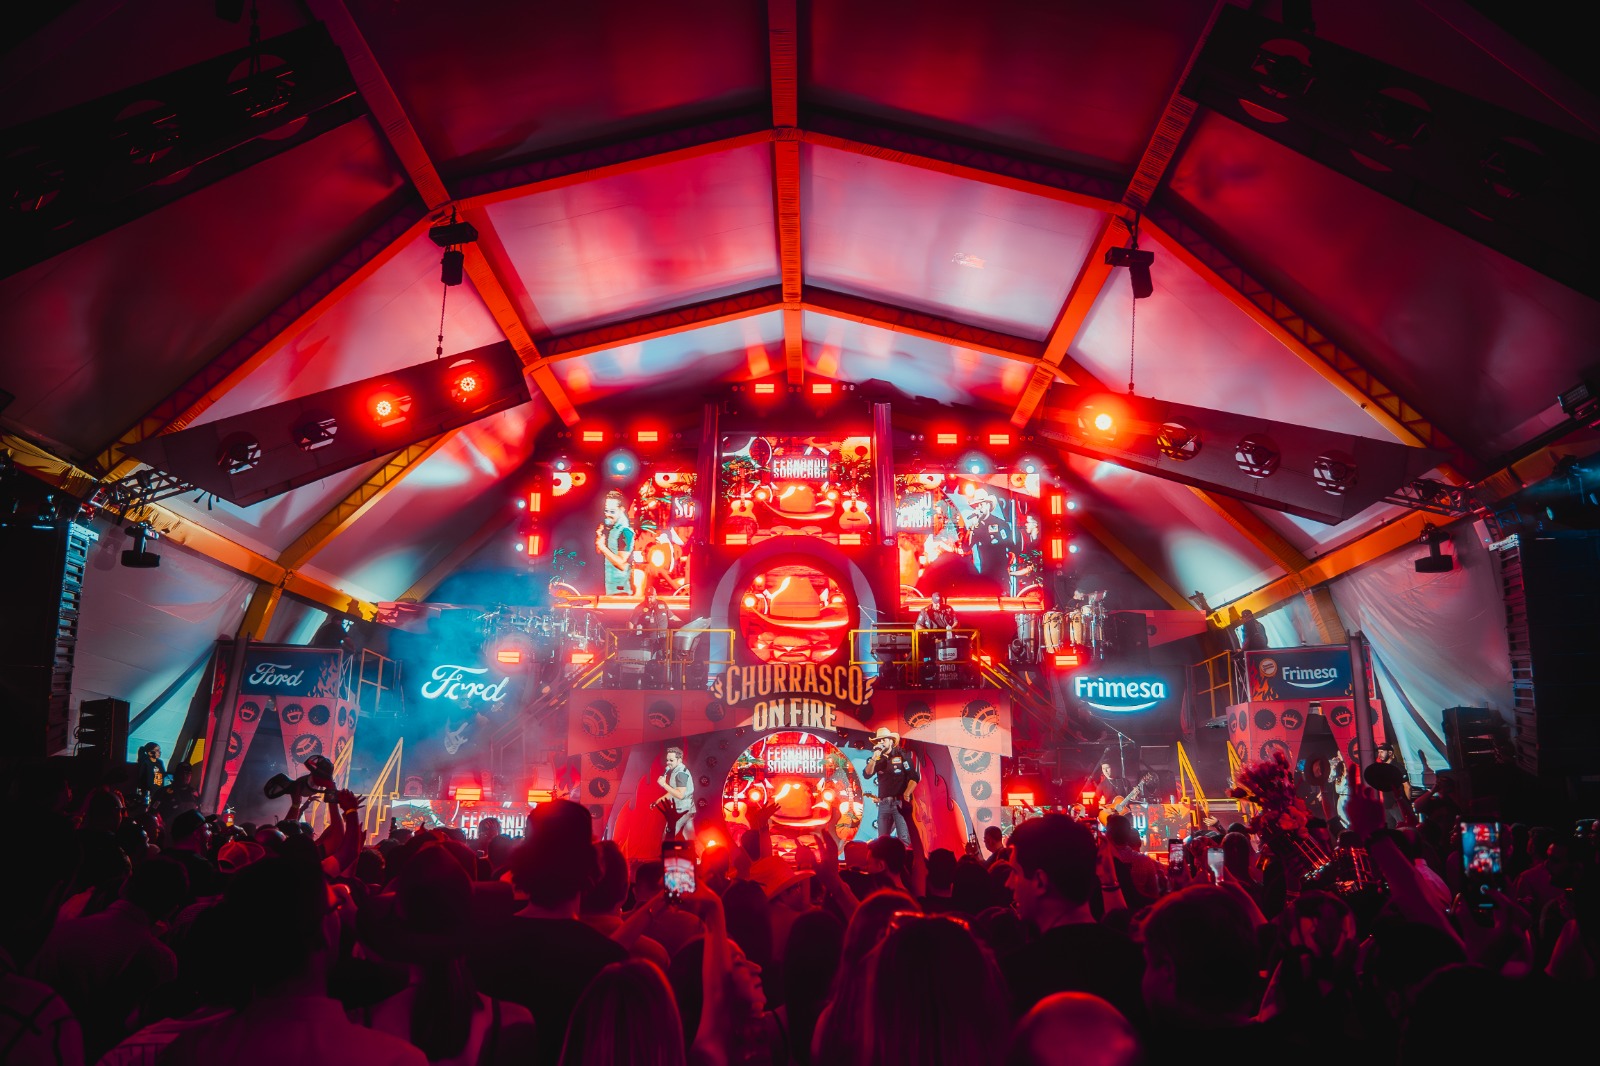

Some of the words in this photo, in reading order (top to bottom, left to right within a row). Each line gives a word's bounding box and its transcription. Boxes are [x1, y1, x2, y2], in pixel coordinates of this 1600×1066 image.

[773, 457, 828, 468] FERNANDO
[773, 467, 828, 479] SOROCABA
[249, 662, 305, 687] Ford
[1282, 666, 1338, 680] Frimesa
[421, 664, 510, 702] Ford
[726, 664, 863, 706] CHURRASCO
[1074, 676, 1165, 699] Frimesa
[753, 699, 786, 732] ON
[789, 697, 838, 732] FIRE
[767, 746, 824, 760] FERNANDO
[767, 759, 824, 774] SOROCABA
